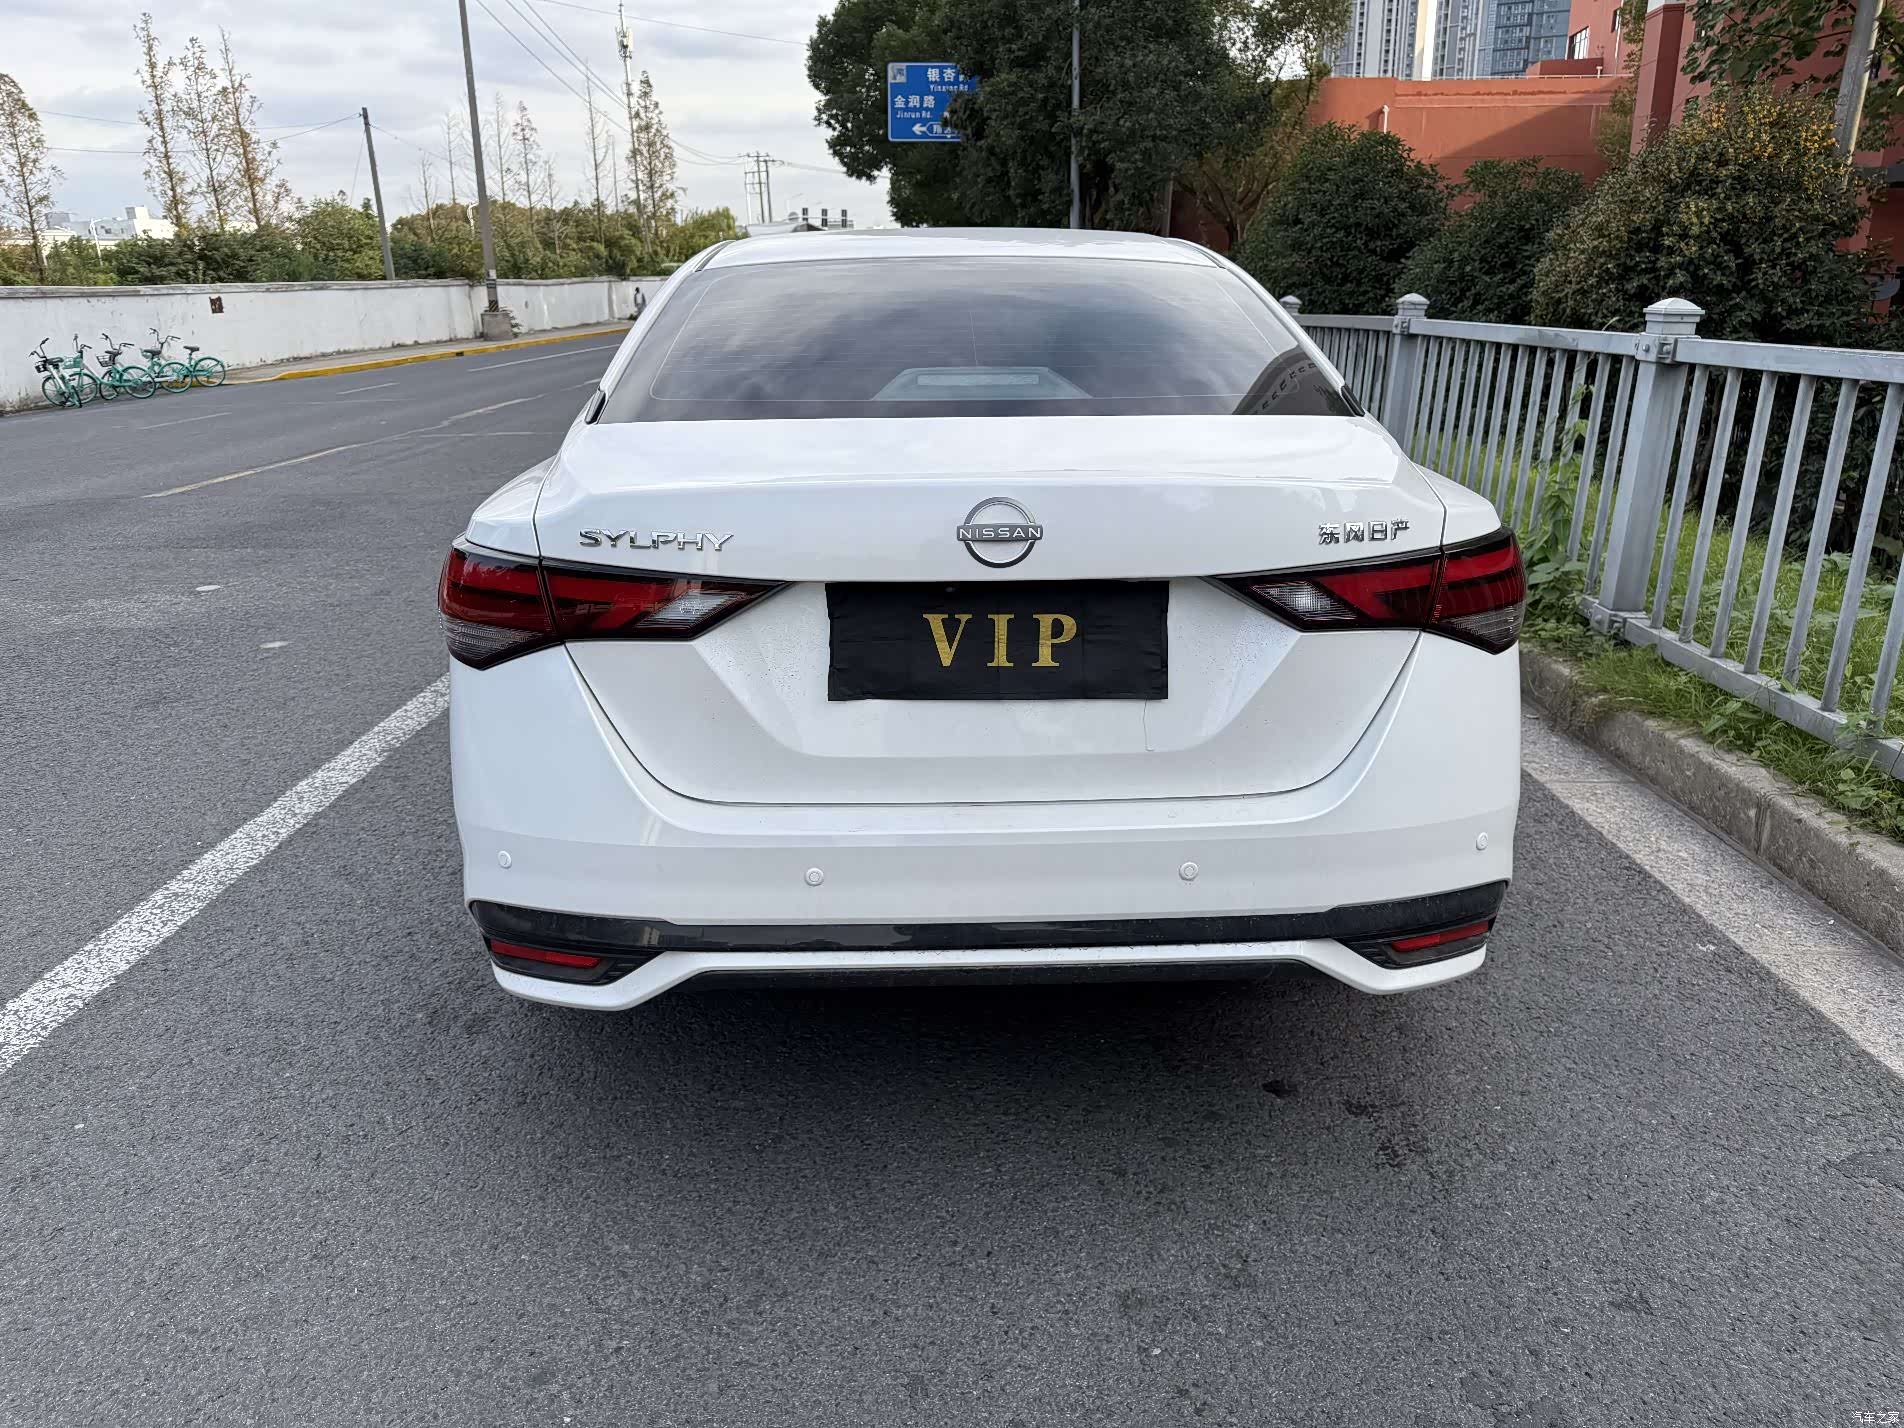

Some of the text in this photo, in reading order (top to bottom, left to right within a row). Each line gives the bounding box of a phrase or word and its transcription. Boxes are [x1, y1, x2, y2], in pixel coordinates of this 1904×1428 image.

[894, 95, 935, 108] 金润路
[579, 528, 735, 551] SYLPHY
[959, 527, 1041, 538] NISSAN
[1318, 518, 1410, 545] 东风日产
[922, 613, 1078, 667] VIP
